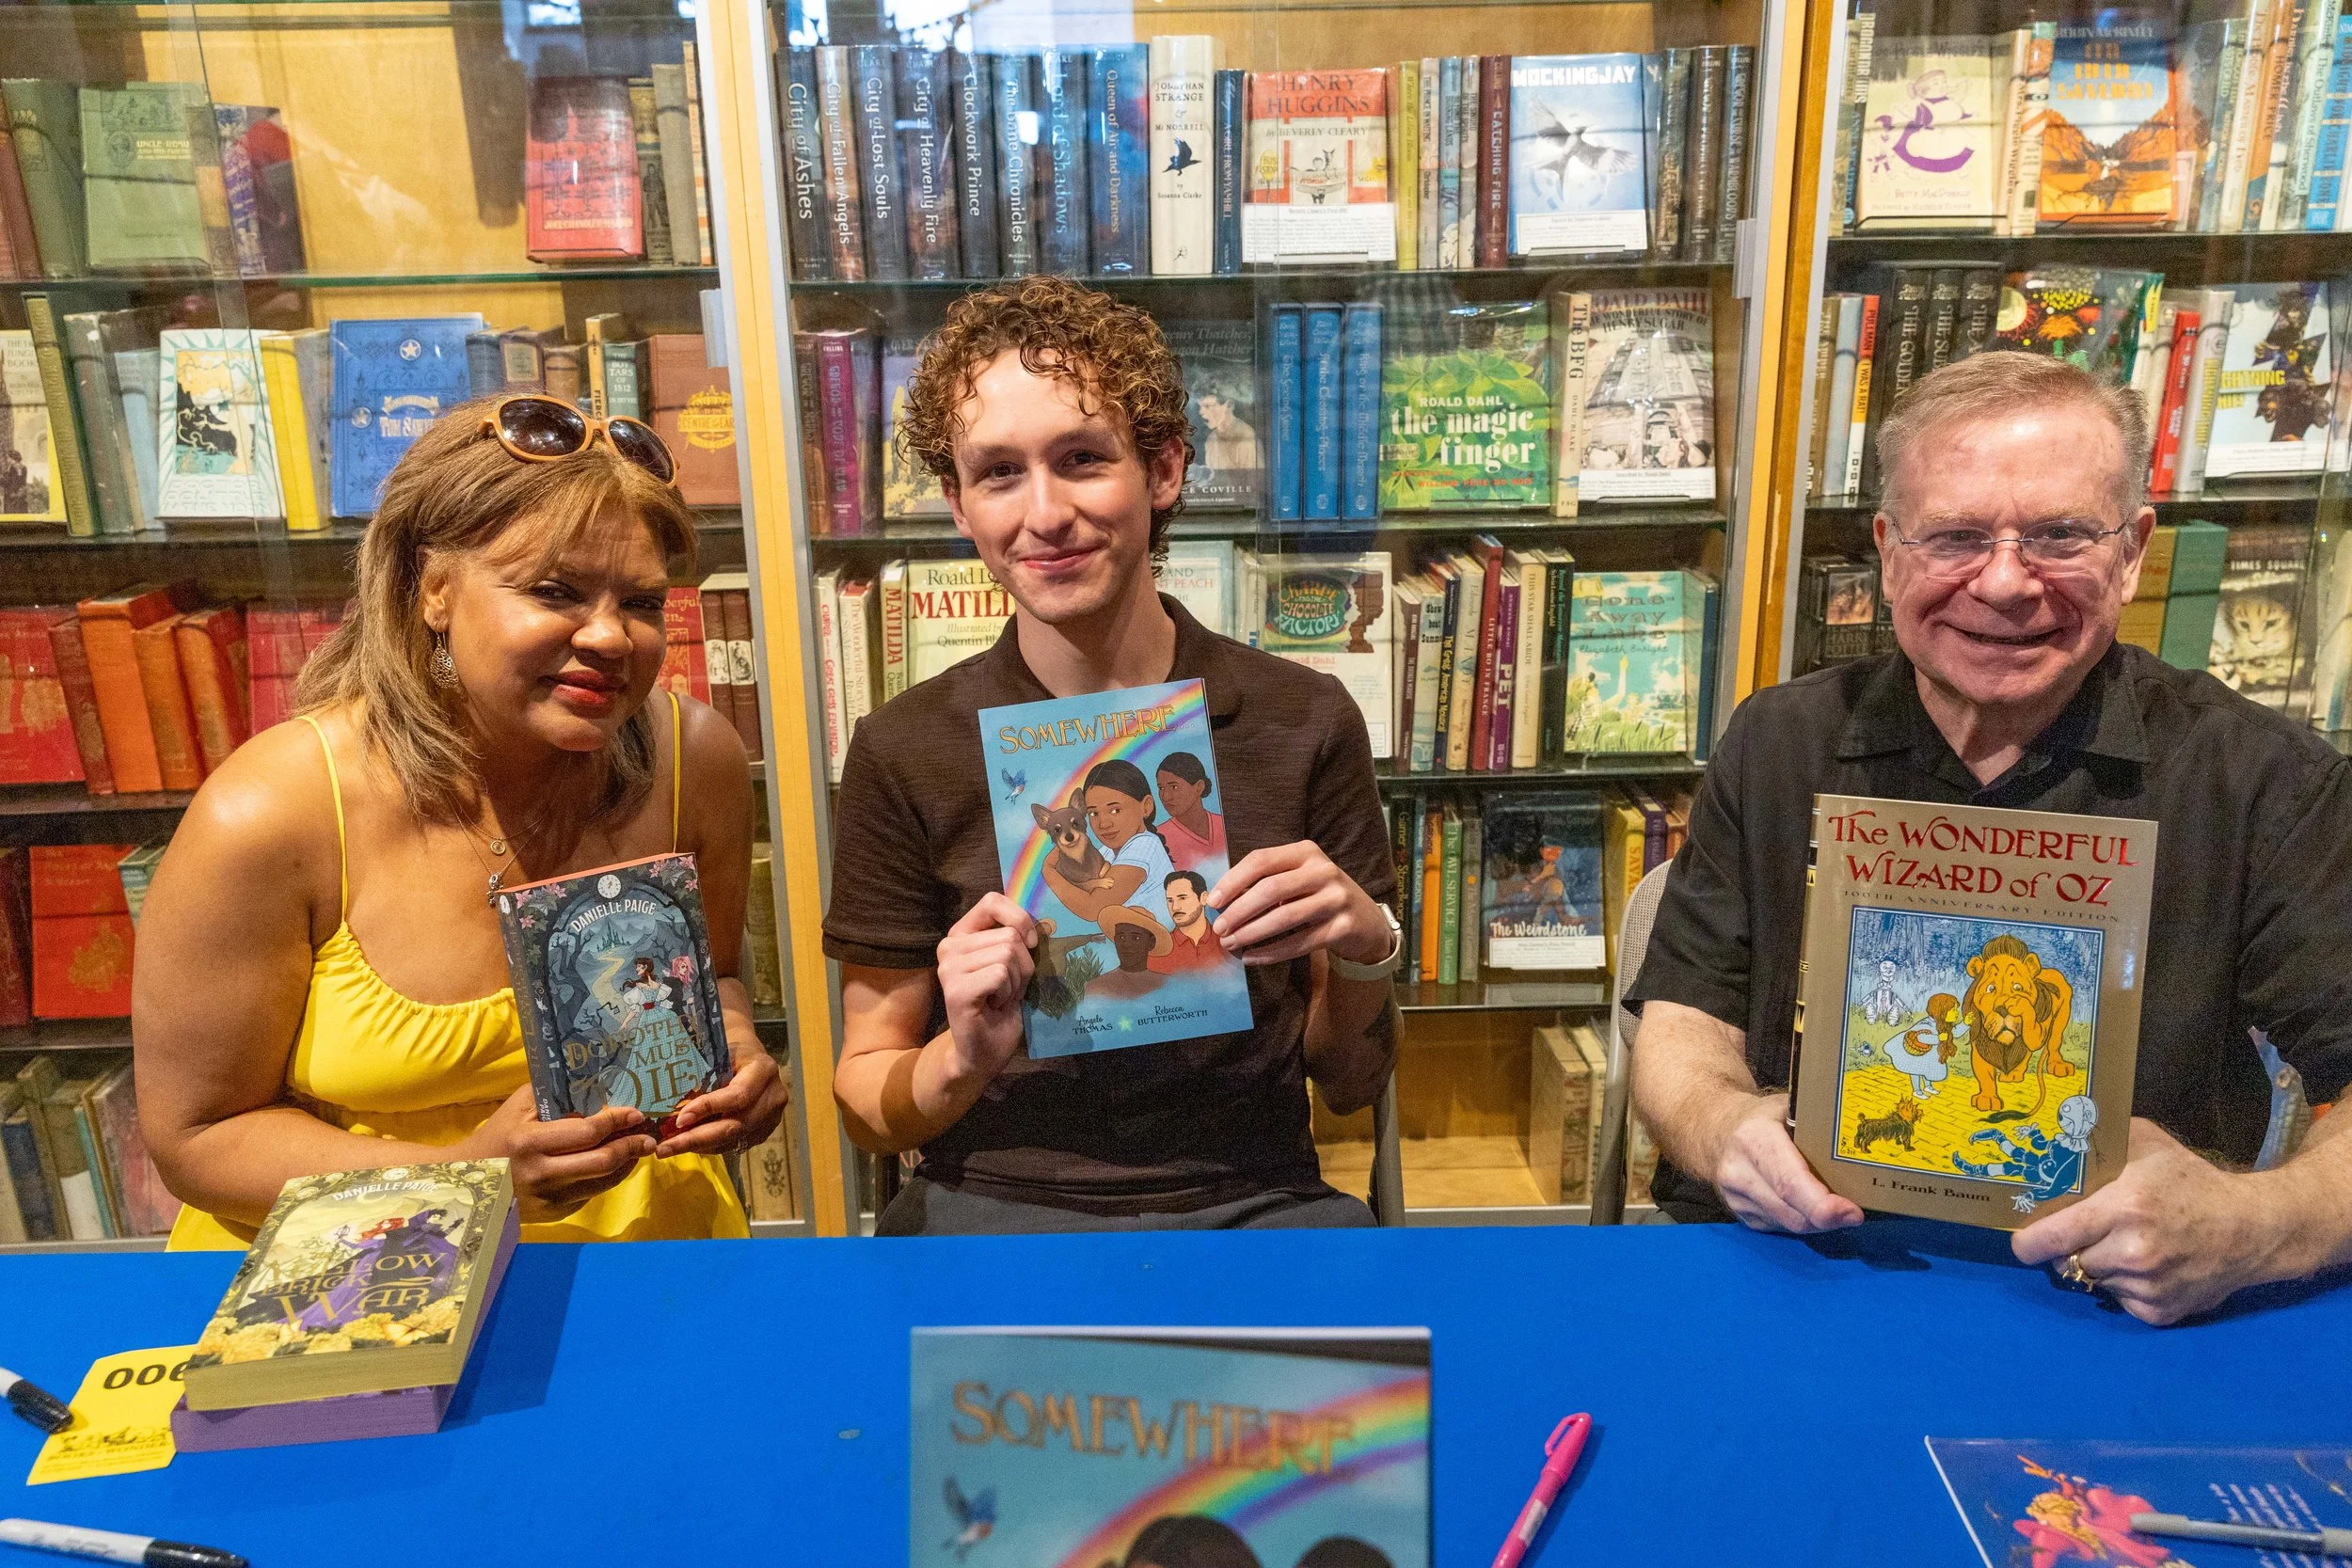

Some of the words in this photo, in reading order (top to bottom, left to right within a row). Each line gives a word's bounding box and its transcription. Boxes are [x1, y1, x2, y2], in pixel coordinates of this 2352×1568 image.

[1512, 65, 1635, 86] MOCKINGJAY
[2267, 56, 2284, 100] HOMER
[2317, 56, 2329, 78] The
[864, 76, 883, 114] City
[913, 77, 931, 114] City
[1052, 72, 1070, 119] Lord
[1106, 69, 1119, 111] Queen
[1281, 73, 1355, 92] HENRY
[787, 80, 807, 130] City
[824, 83, 842, 118] City
[1155, 93, 1204, 103] STRANGE
[1266, 95, 1371, 115] HUGGINS
[2308, 79, 2326, 123] Outlaws
[829, 121, 842, 134] of
[868, 117, 884, 130] of
[917, 117, 933, 132] of
[962, 75, 980, 163] Clockwork
[1107, 112, 1120, 129] of
[1279, 127, 1325, 137] BEVERLY
[1327, 126, 1367, 136] CLEARY
[2263, 106, 2276, 141] PRICE
[2306, 125, 2316, 135] of
[792, 134, 810, 155] of
[1052, 124, 1071, 149] of
[1108, 130, 1120, 150] Air
[1224, 130, 1232, 151] GIRL
[1491, 111, 1503, 175] CATCHING
[832, 139, 848, 185] Fallen
[871, 134, 887, 169] Lost
[1109, 150, 1121, 174] and
[2296, 137, 2315, 191] Sherwood
[919, 134, 937, 210] Heavenly
[1223, 154, 1232, 182] FROM
[794, 155, 816, 220] Ashes
[875, 173, 892, 220] Souls
[967, 166, 983, 217] Prince
[1008, 155, 1026, 245] Chronicles
[1053, 149, 1072, 234] Shadows
[1491, 181, 1502, 210] FIRE
[1110, 176, 1123, 234] Darkness
[1222, 182, 1232, 221] YAMHILL
[832, 191, 853, 245] Angels
[925, 214, 940, 245] Fire
[1654, 292, 1708, 316] DAHL
[1664, 308, 1694, 322] STORY
[1570, 303, 1588, 336] The
[1644, 316, 1685, 331] SUGAR
[1863, 309, 1876, 351] PULLMAN
[1900, 305, 1919, 337] THE
[1935, 305, 1954, 337] THE
[1971, 305, 1988, 335] THE
[1203, 341, 1252, 355] Hatcher
[1568, 341, 1586, 379] BFG
[1858, 368, 1869, 387] WAS
[1894, 340, 1916, 399] GOLDEN
[613, 385, 631, 393] 1812
[1420, 397, 1463, 408] ROALD
[1468, 395, 1504, 407] DAHL
[1855, 395, 1867, 414] RAT!
[380, 417, 403, 438] TOM
[681, 416, 713, 431] CENTRE
[1391, 405, 1438, 436] the
[1447, 403, 1534, 441] magic
[1568, 423, 1578, 452] BLAKE
[1440, 436, 1536, 473] finger
[1201, 485, 1252, 494] COVILLE
[927, 566, 974, 586] Roald
[1168, 567, 1195, 578] AND
[1175, 578, 1214, 589] PEACH
[1528, 572, 1536, 592] THIS
[851, 602, 861, 621] The
[1281, 602, 1335, 619] CHOCOLATE
[1526, 593, 1535, 613] STAR
[1581, 595, 1675, 607] Gone-
[885, 587, 903, 666] MATILDA
[946, 623, 992, 635] Illustrated
[1273, 609, 1341, 636] FACTORY
[1525, 613, 1535, 641] SHALL
[1588, 611, 1666, 626] Away
[851, 622, 864, 671] Wonderful
[937, 635, 983, 647] Quentin
[1443, 636, 1454, 649] The
[1486, 617, 1496, 650] LITTLE
[1441, 650, 1453, 671] Great
[1485, 653, 1493, 665] BO
[1524, 641, 1534, 666] ABIDE
[1580, 643, 1627, 655] Elizabeth
[1629, 643, 1670, 656] Enright
[825, 658, 836, 685] GREAT
[1484, 668, 1492, 679] IN
[827, 688, 837, 709] GLASS
[854, 676, 866, 702] Story
[1439, 672, 1452, 704] American
[1481, 681, 1492, 716] FRANCE
[1497, 663, 1514, 709] PET
[857, 704, 866, 714] of
[1397, 811, 1409, 847] Garner
[1446, 830, 1457, 848] The
[1828, 809, 1889, 846] The
[1898, 816, 2140, 867] WONDERFUL
[1446, 850, 1457, 877] OWL
[1846, 849, 2003, 895] WIZARD
[2009, 871, 2052, 899] of
[2056, 872, 2115, 908] OZ
[570, 900, 623, 934] DANIELLE
[624, 898, 658, 916] PAIGE
[1445, 879, 1457, 928] SERVICE
[1844, 890, 1895, 901] 100TH
[1903, 895, 2033, 915] ANNIVERSARY
[2042, 910, 2121, 924] EDITION
[1489, 921, 1513, 938] The
[1515, 920, 1588, 938] Weirdstone
[1443, 938, 1453, 954] Alan
[1443, 955, 1453, 981] Garner
[1072, 1022, 1114, 1036] THOMAS
[1137, 1009, 1209, 1026] BUTTERWORTH
[1154, 1005, 1185, 1017] Rebecca
[332, 1181, 403, 1202] DANIELLE
[401, 1180, 440, 1194] PAIGE
[1872, 1177, 1885, 1188] L.
[1891, 1180, 1938, 1196] Frank
[1943, 1188, 1991, 1202] Baum
[262, 1271, 372, 1298] BRICK
[276, 1275, 431, 1327] WAR
[950, 1379, 1357, 1476] SOMEWHERE
